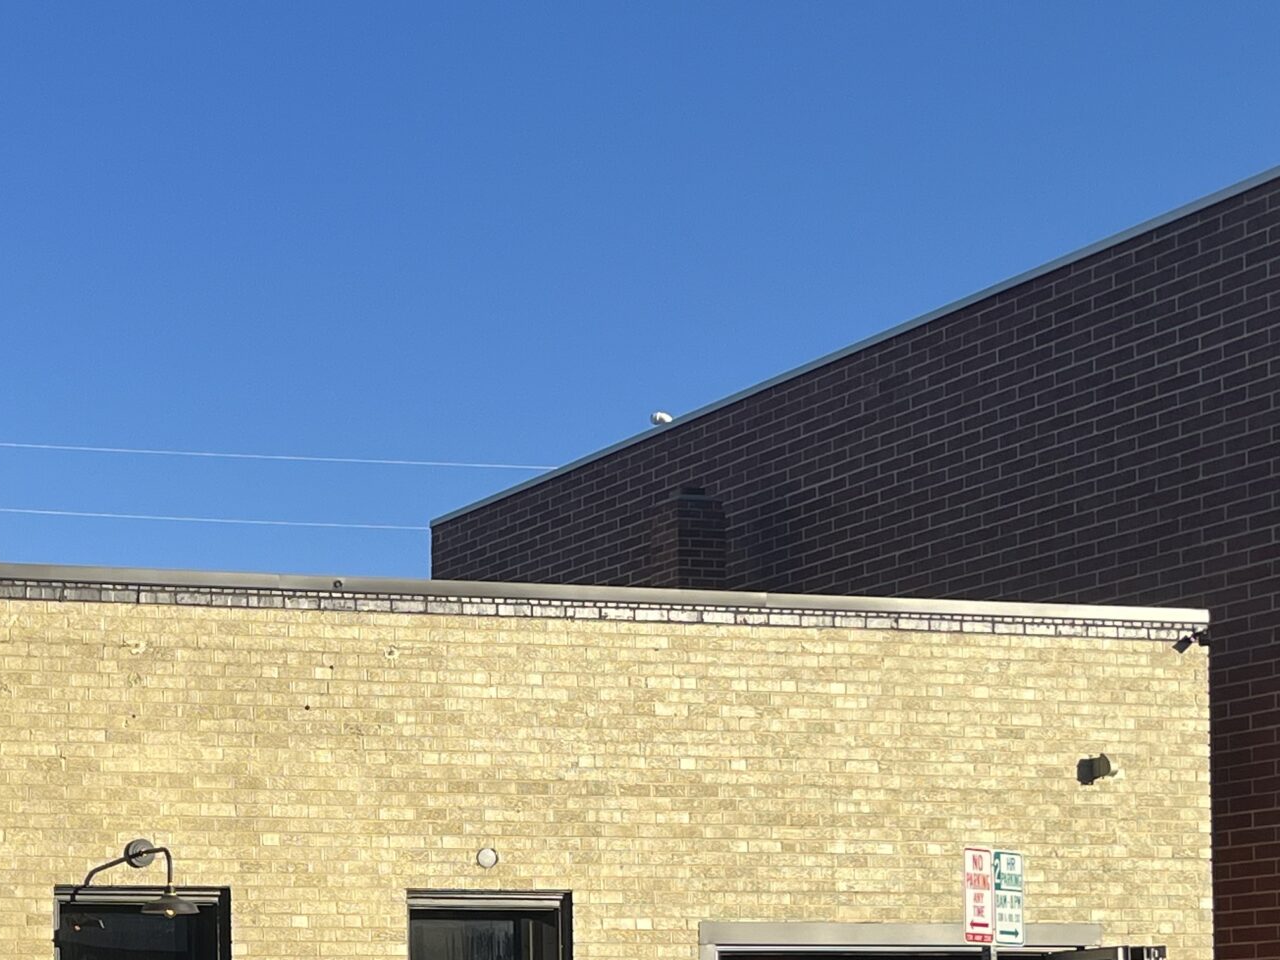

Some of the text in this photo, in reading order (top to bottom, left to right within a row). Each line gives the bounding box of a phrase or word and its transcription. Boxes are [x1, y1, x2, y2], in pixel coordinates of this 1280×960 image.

[972, 854, 983, 871] NO
[994, 857, 1016, 883] 2 HR
[966, 872, 990, 890] PARKING
[973, 892, 984, 904] ANY
[973, 905, 985, 918] TIME
